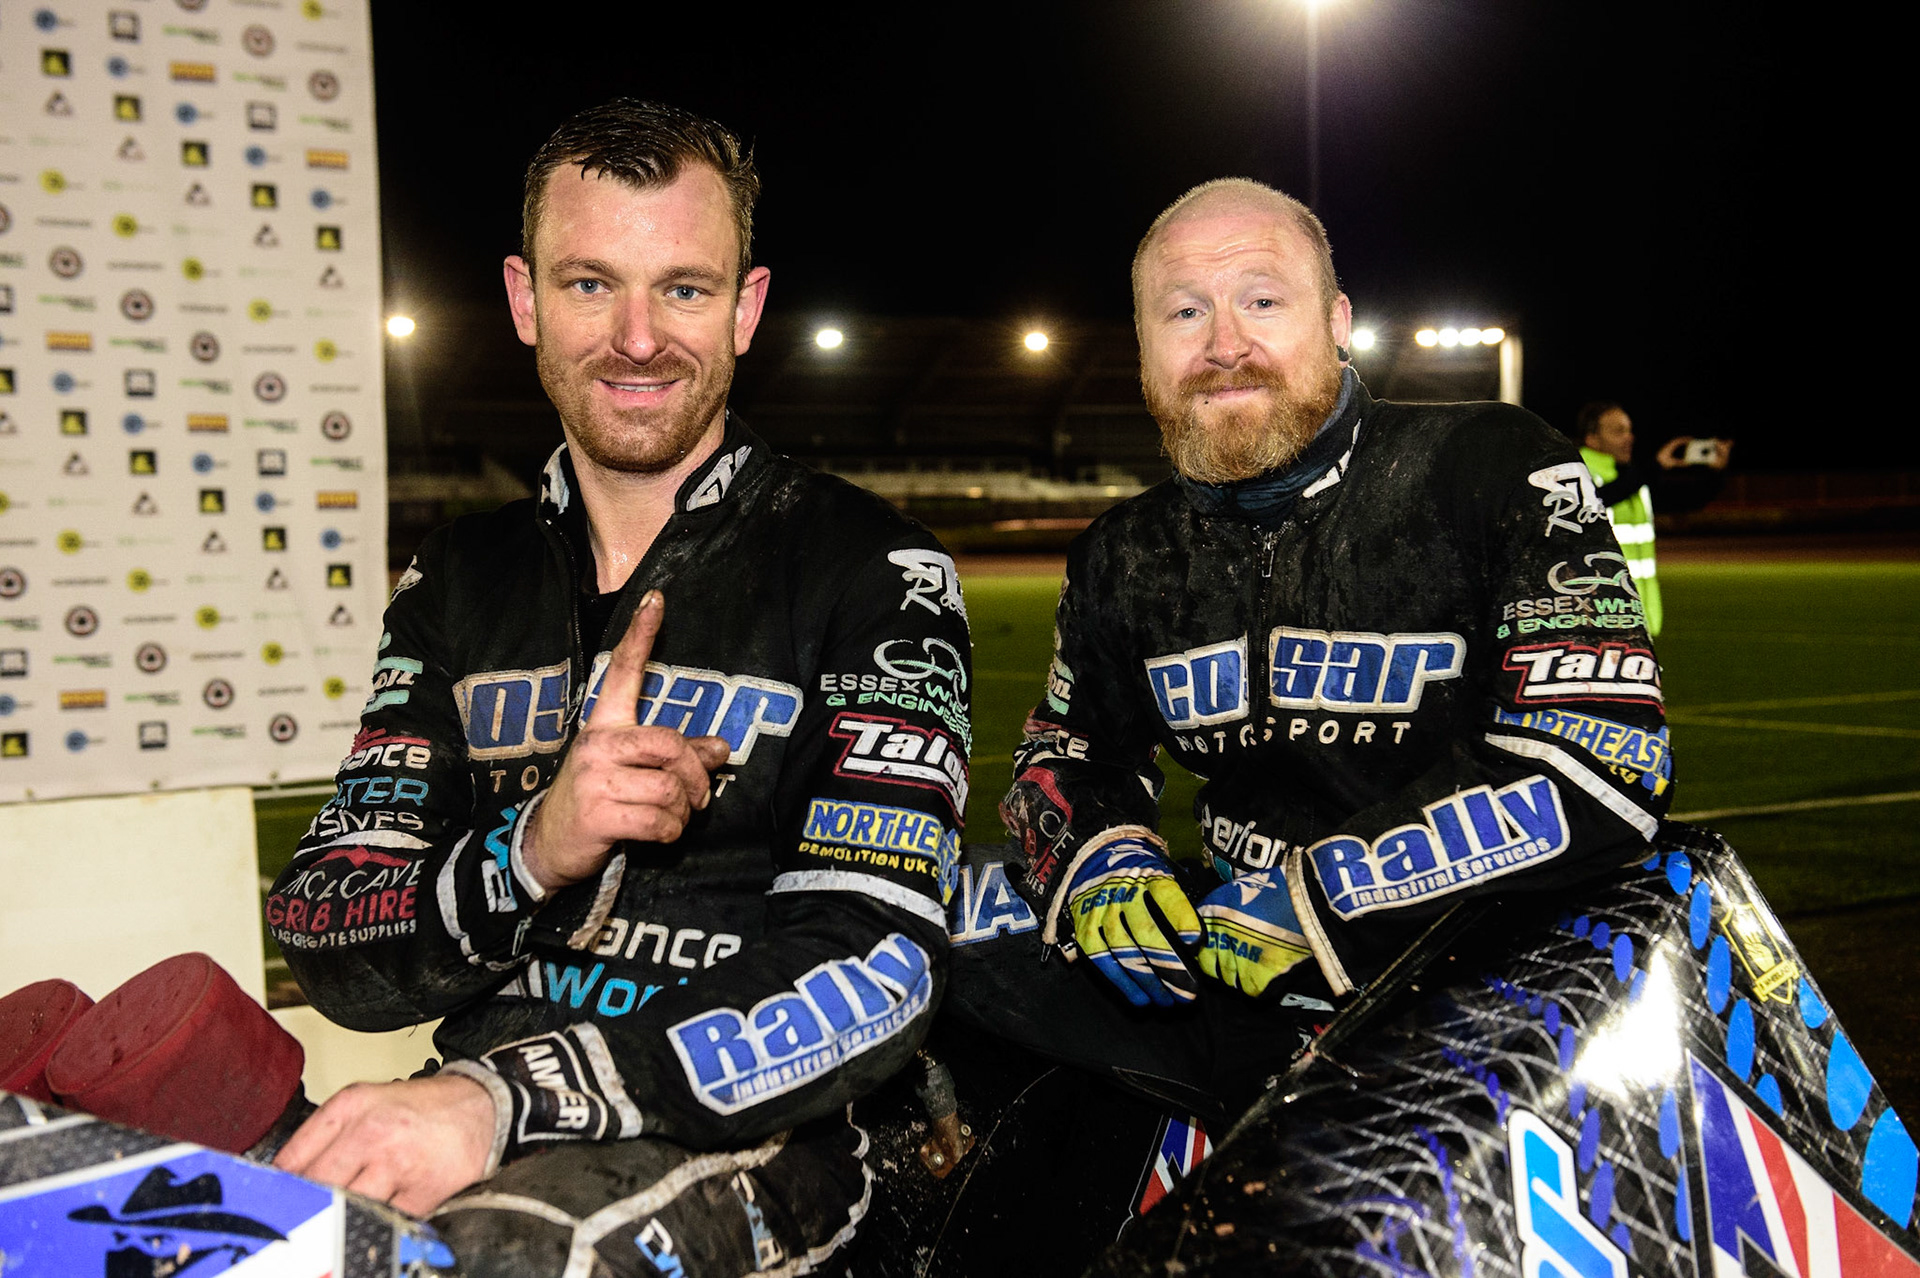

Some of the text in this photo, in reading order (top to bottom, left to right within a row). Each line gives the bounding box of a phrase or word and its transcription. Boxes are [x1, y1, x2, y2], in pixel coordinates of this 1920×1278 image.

[1503, 596, 1594, 621] ESSEX
[820, 673, 920, 694] ESSEX
[1512, 649, 1660, 685] Talo
[798, 841, 899, 869] DEMOLITION
[903, 857, 928, 874] UK
[1311, 778, 1563, 901] Rally
[1351, 837, 1550, 908] Industrial Services
[344, 886, 417, 927] HIRE
[674, 933, 931, 1090] Rally
[733, 1042, 840, 1101] Industrial
